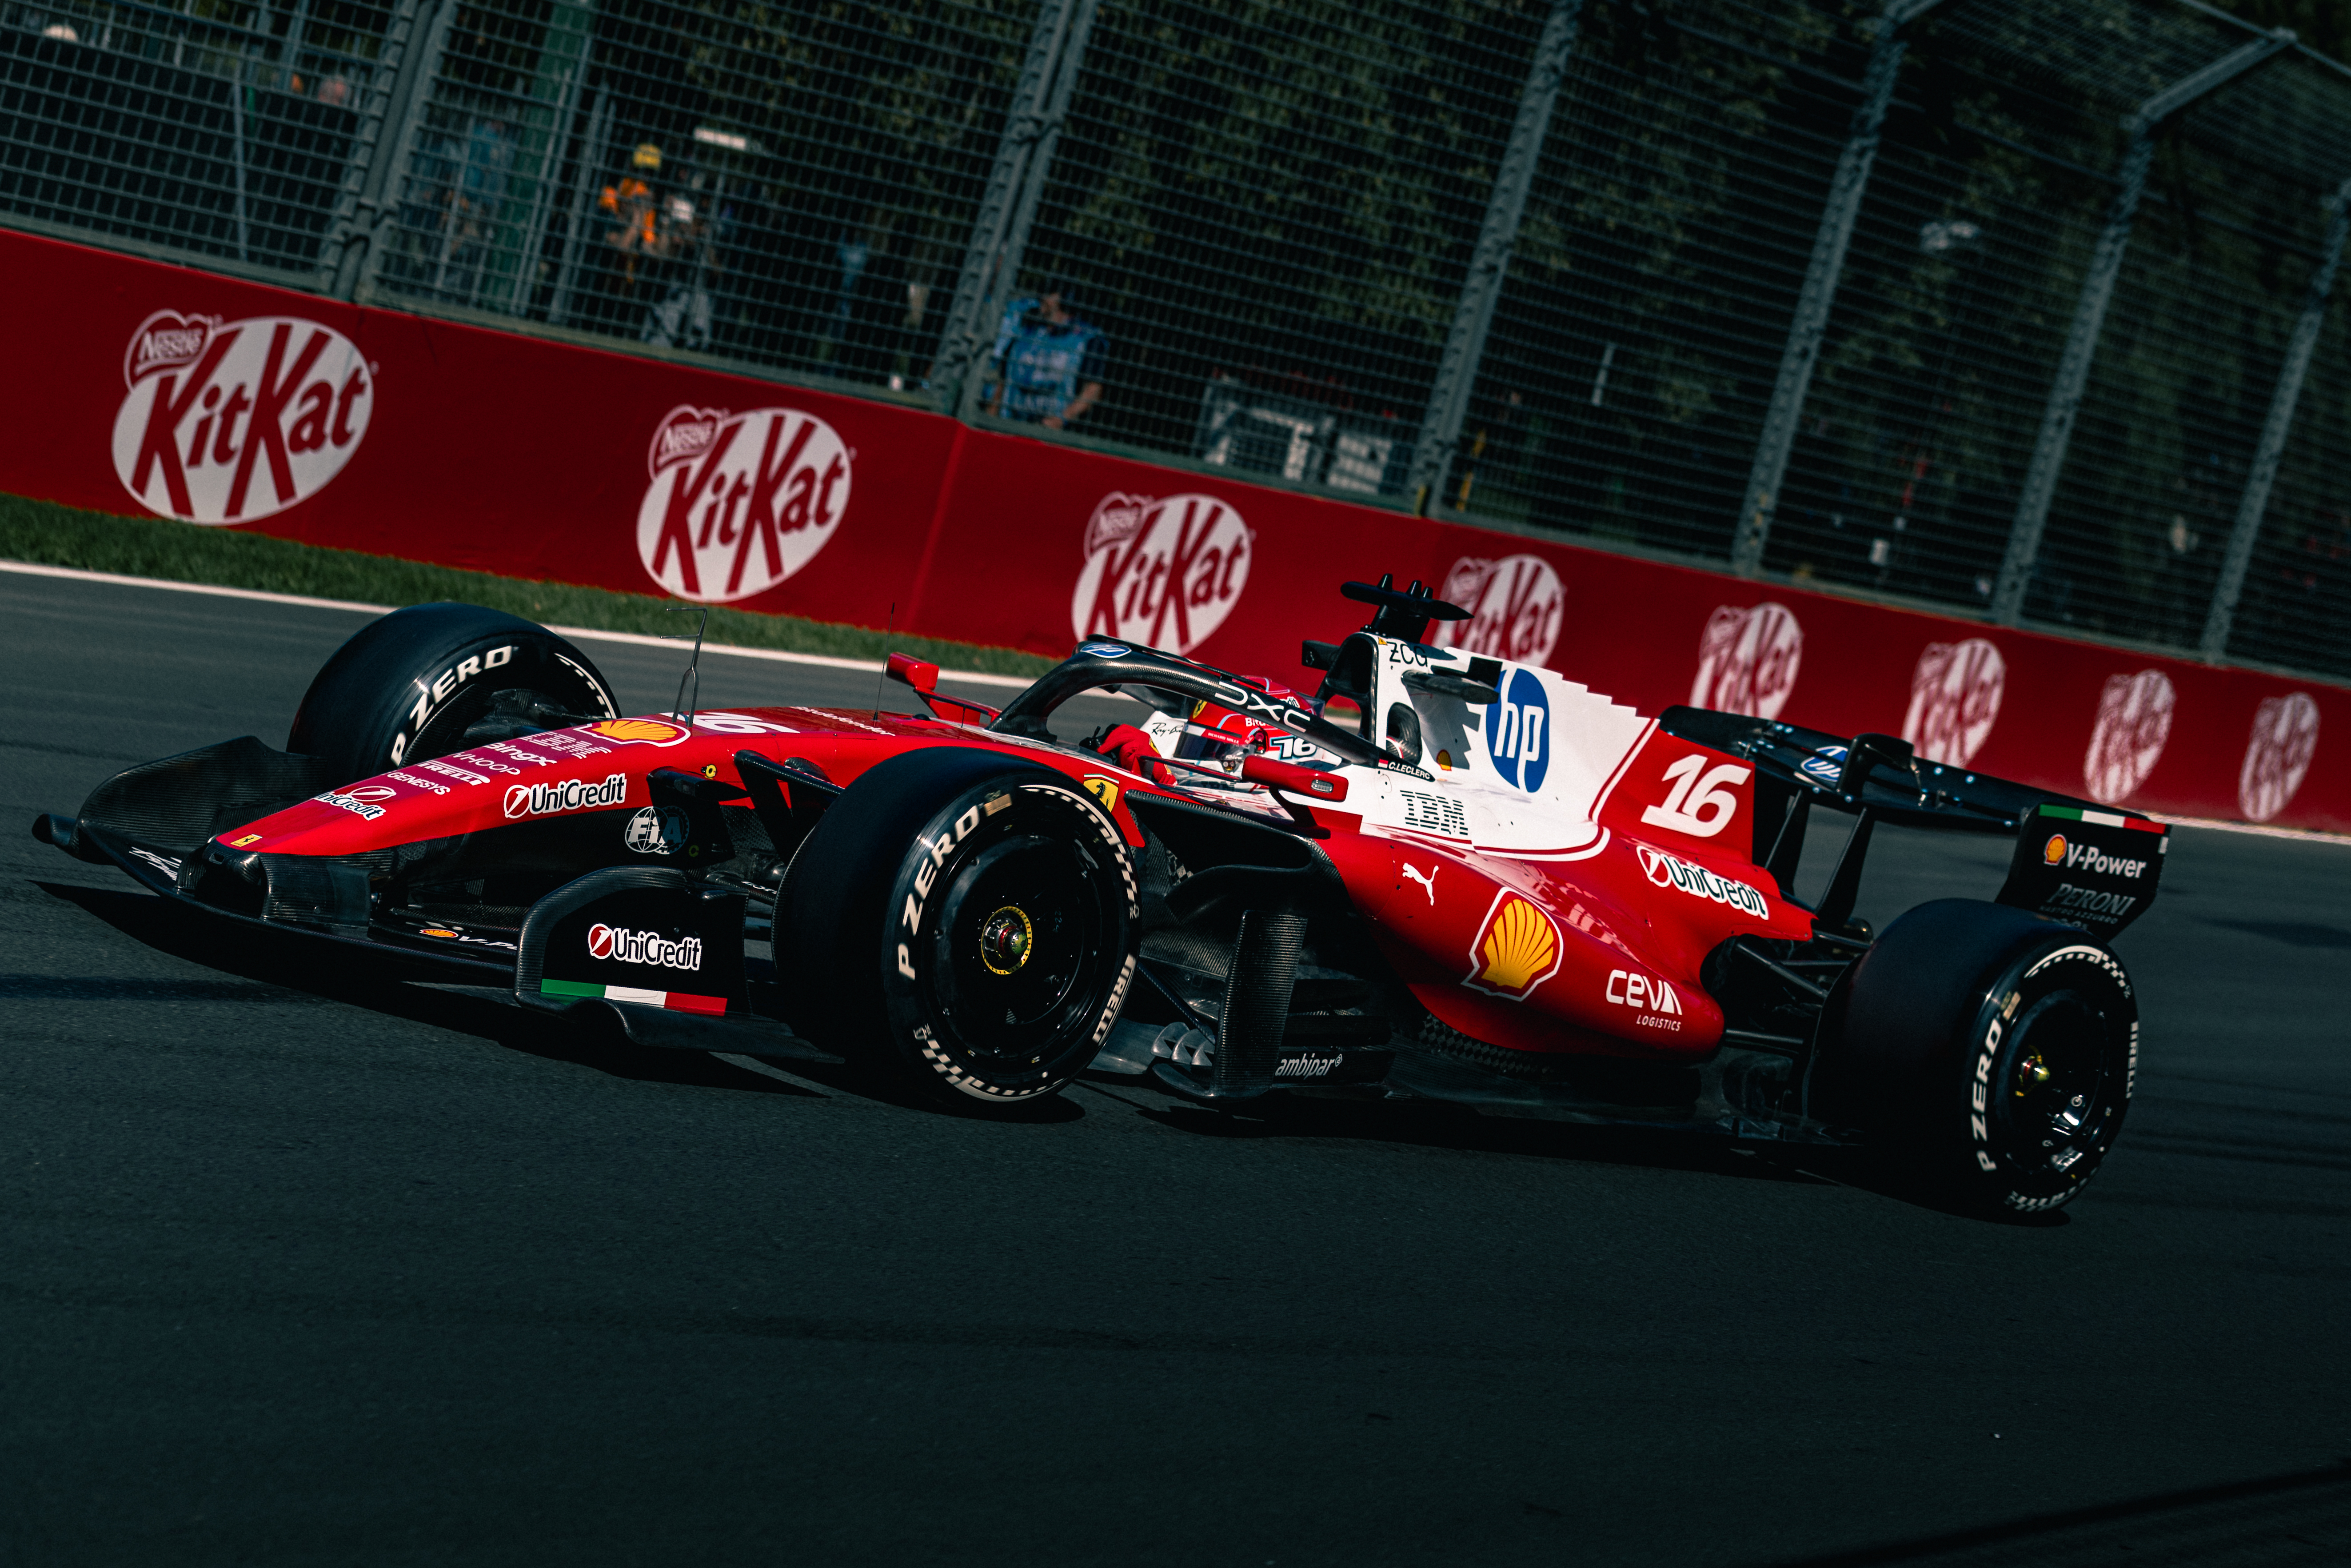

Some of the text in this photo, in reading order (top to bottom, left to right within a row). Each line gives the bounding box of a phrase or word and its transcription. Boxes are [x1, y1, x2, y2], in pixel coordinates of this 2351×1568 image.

[132, 323, 367, 518] KitKat
[651, 415, 844, 594] KitKat
[1386, 641, 1428, 667] ZCG
[391, 646, 513, 767] P ZERO
[1214, 681, 1310, 733] DXC
[1494, 669, 1545, 790] hp
[1270, 736, 1317, 760] 16
[1388, 762, 1430, 780] C.LECLERC
[387, 772, 451, 795] GENESYS
[532, 776, 624, 810] UniCredit
[1640, 753, 1752, 838] 16
[1399, 789, 1469, 836] IBM
[2067, 842, 2147, 878] V-Power
[898, 804, 980, 981] P ZERO
[1663, 853, 1766, 916] UniCredit
[2046, 883, 2136, 916] PERONI
[614, 929, 701, 969] UniCredit
[1091, 954, 1136, 1043] PIRELLI
[1636, 1014, 1681, 1032] LOGISTICS
[1275, 1053, 1335, 1080] ambipar
[1971, 1018, 2003, 1172] P ZERO
